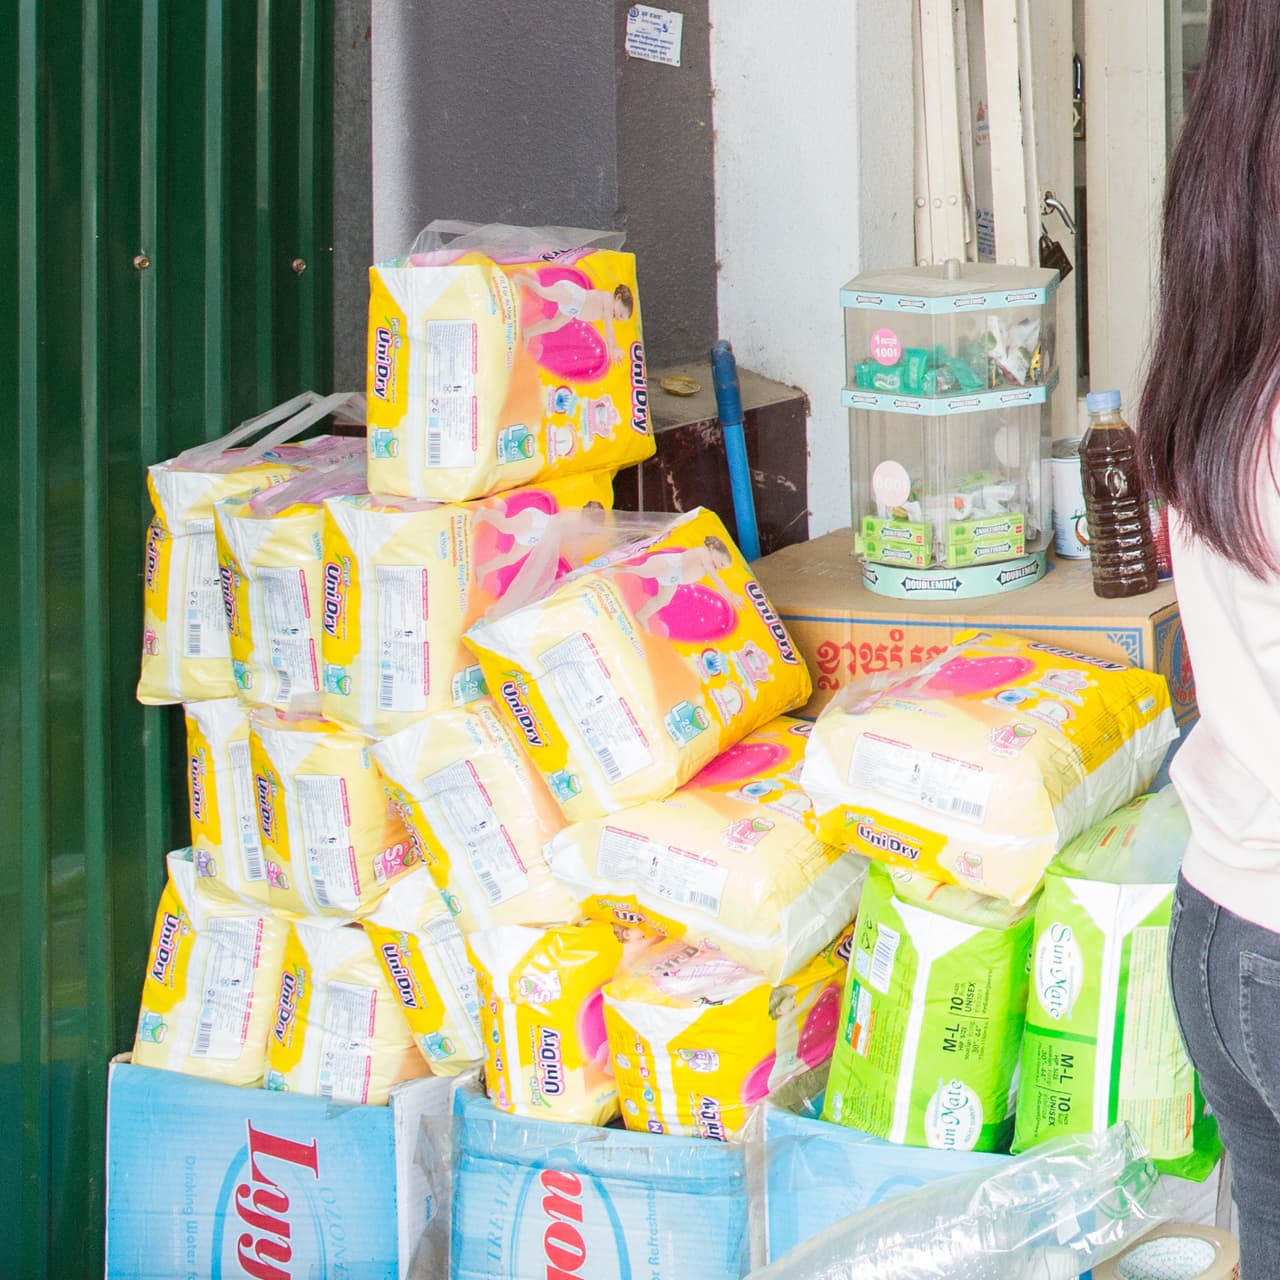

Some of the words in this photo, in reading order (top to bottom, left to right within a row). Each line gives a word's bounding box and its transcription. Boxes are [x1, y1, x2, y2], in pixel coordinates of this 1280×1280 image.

[904, 579, 957, 590] DOUBLEMINT
[949, 995, 964, 1011] 10
[964, 981, 977, 1013] UNISEX
[943, 1022, 959, 1053] M-L
[1058, 1053, 1073, 1084] M-L
[1048, 1095, 1058, 1127] UNISEX
[1058, 1095, 1071, 1113] 10
